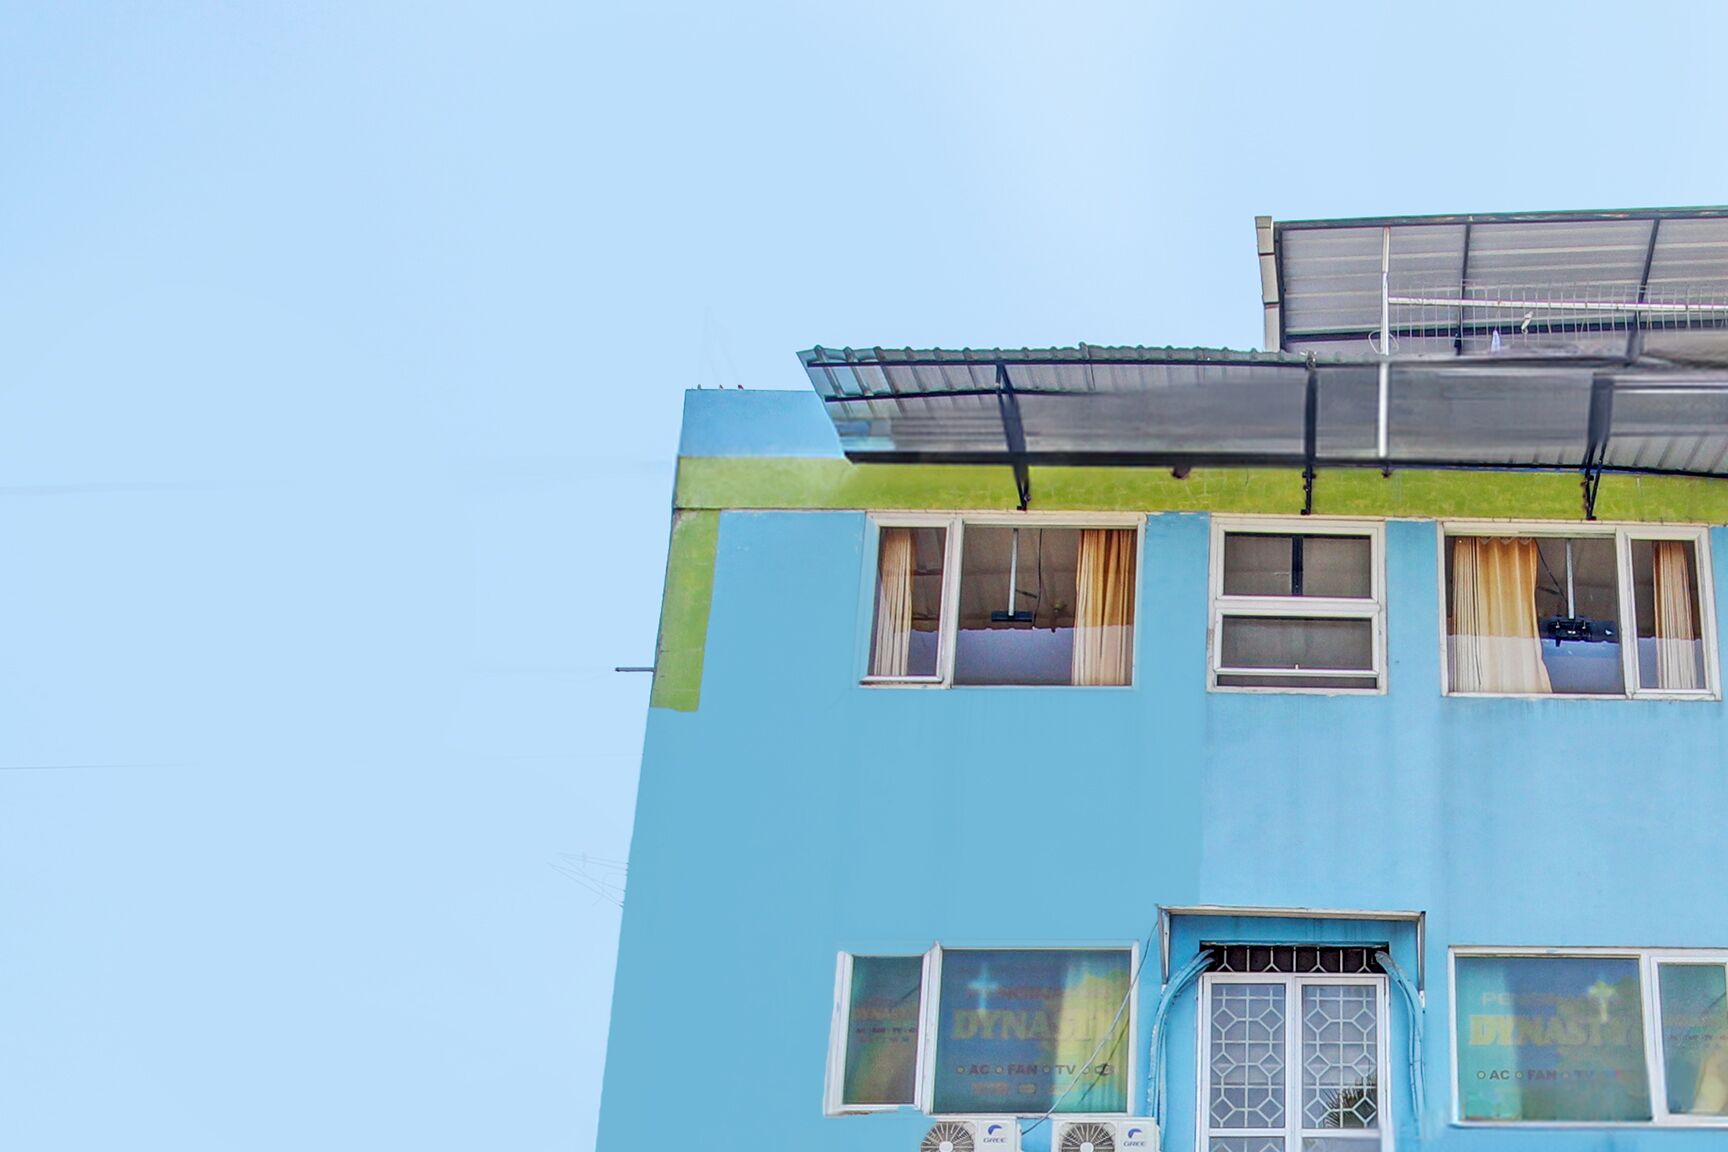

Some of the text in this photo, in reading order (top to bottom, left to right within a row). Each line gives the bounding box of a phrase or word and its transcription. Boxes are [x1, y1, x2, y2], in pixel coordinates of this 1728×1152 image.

[968, 1064, 1077, 1076] AC FAN TV
[1489, 1069, 1511, 1081] AC
[1527, 1069, 1558, 1081] FAN
